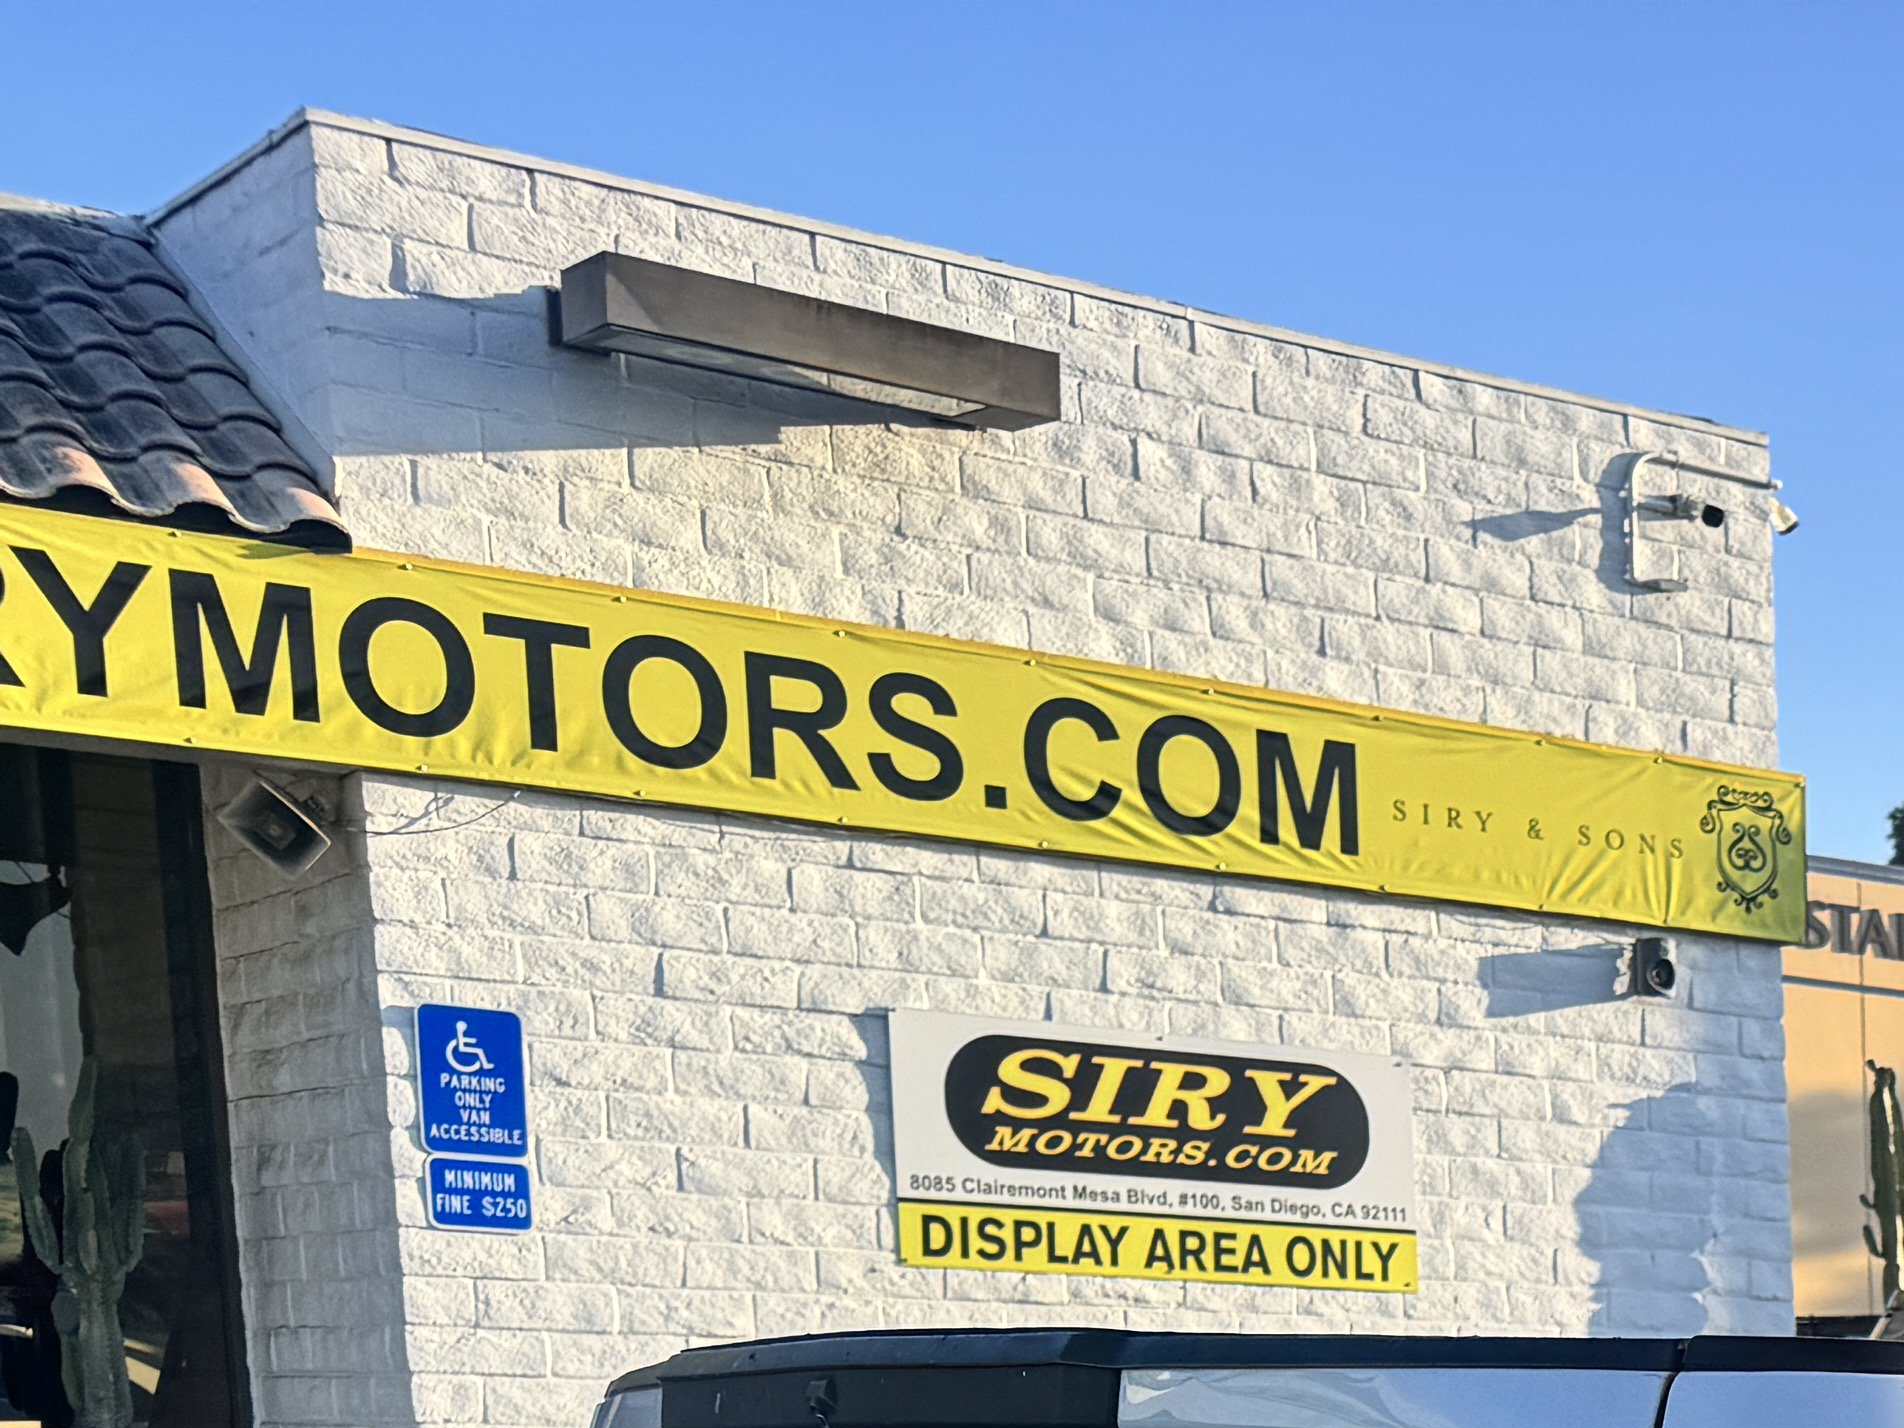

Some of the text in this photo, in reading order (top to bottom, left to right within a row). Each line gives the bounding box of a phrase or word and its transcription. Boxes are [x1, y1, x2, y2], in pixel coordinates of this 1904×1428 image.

[0, 544, 1358, 856] YMOTORS.COM
[1392, 799, 1684, 859] SIRY & SONS
[440, 1072, 506, 1094] PARKING
[454, 1091, 493, 1109] ONLY
[980, 1048, 1338, 1138] SIRY
[429, 1123, 523, 1146] ACCESSIBLE
[459, 1108, 491, 1125] VAN
[984, 1126, 1338, 1175] MOTORS.COM
[443, 1168, 516, 1193] MINIMUM
[910, 1174, 1407, 1223] 8085 Clairemont Mesa Blvd, #100, San Diego, CA 92111
[435, 1193, 527, 1219] FINE $250
[921, 1214, 1400, 1282] DISPLAY AREA ONLY
